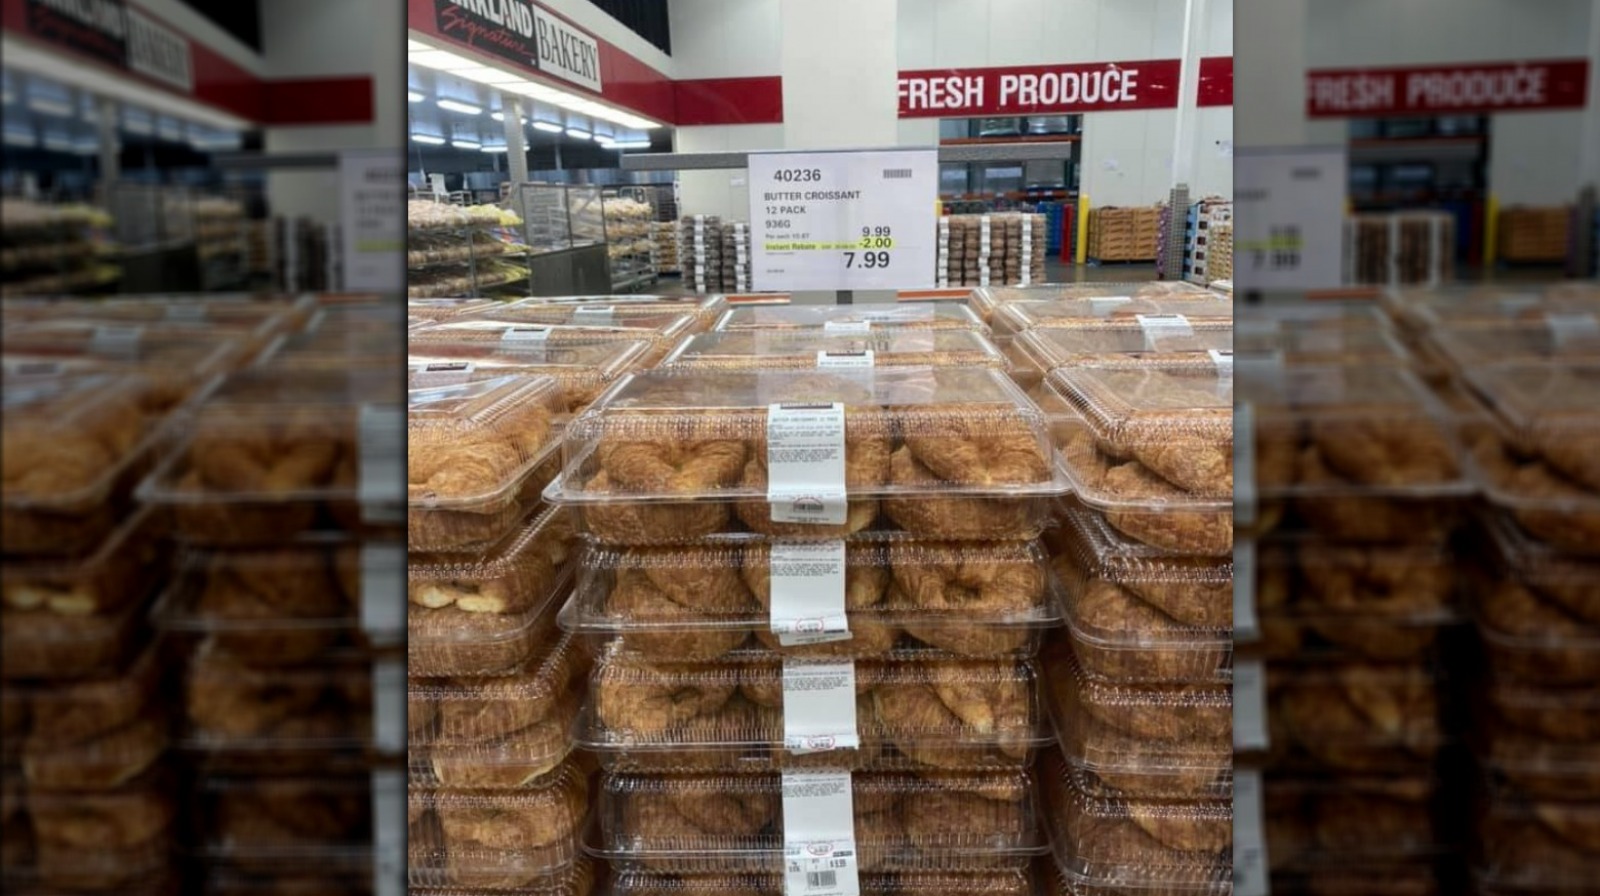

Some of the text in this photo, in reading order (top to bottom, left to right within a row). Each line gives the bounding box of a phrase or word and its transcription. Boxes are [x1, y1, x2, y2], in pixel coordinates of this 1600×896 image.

[441, 5, 536, 56] Signature
[536, 14, 598, 83] BAKERY
[1000, 69, 1139, 106] PRODUCE
[773, 168, 822, 182] 40236
[764, 190, 861, 201] BUTTER CROISSANT
[765, 206, 807, 215] 12 PACK
[765, 219, 791, 229] 936G
[862, 226, 891, 238] 9.99
[765, 243, 790, 251] Instant
[791, 242, 816, 251] Rebate
[859, 237, 892, 249] -2.00
[843, 251, 890, 269] 7.99
